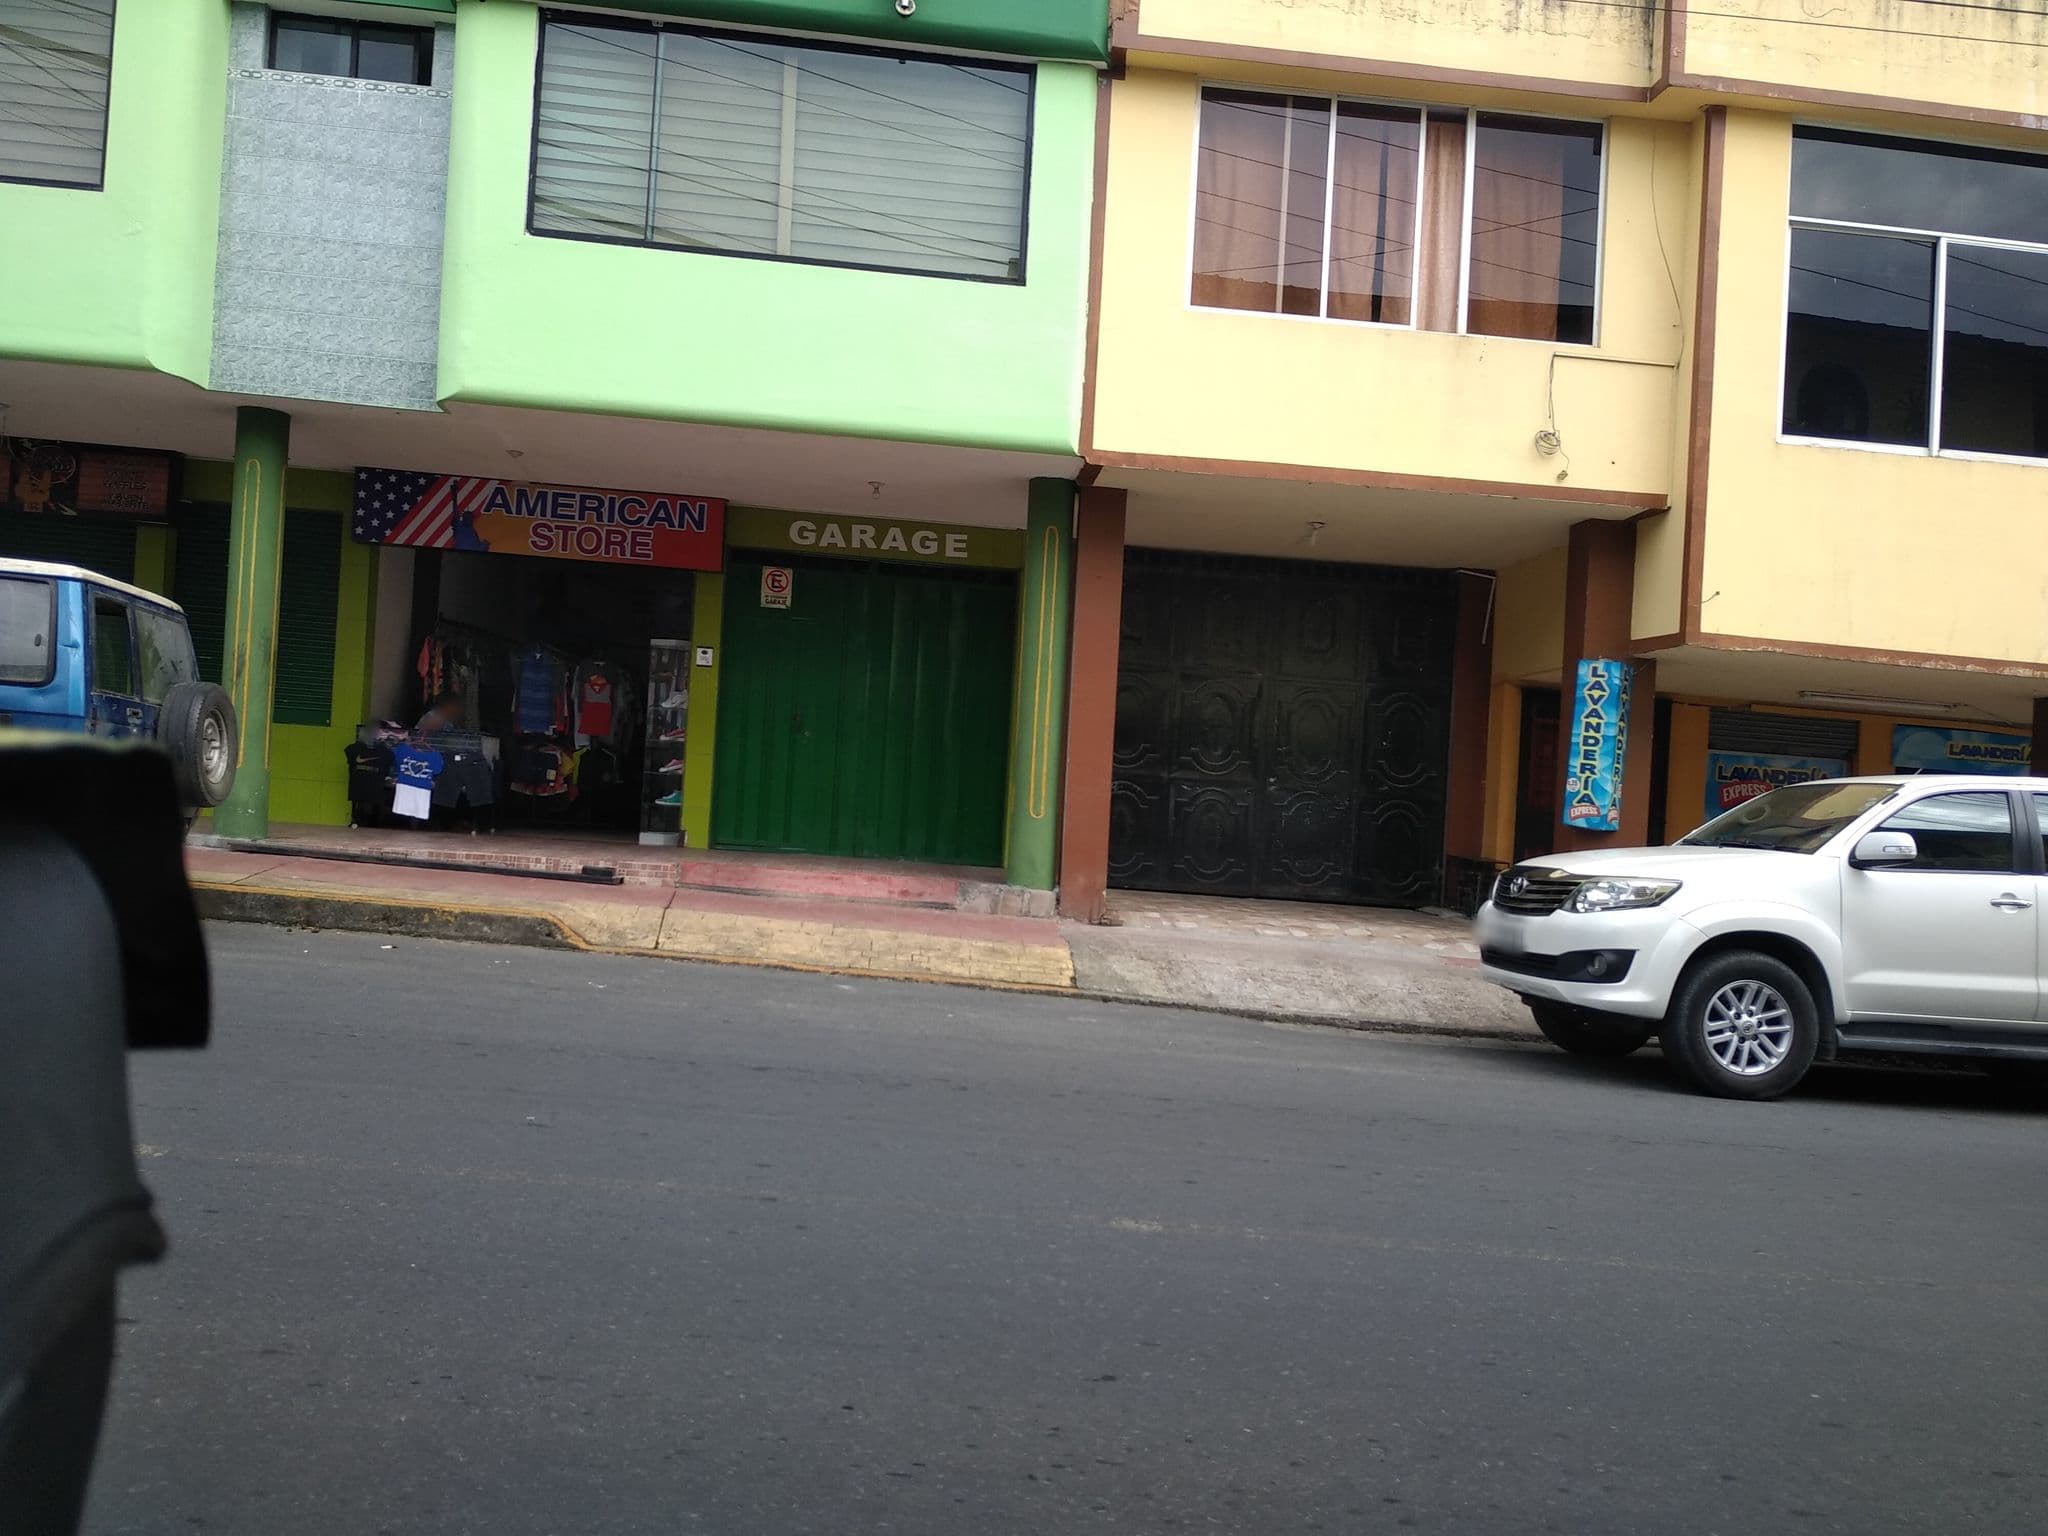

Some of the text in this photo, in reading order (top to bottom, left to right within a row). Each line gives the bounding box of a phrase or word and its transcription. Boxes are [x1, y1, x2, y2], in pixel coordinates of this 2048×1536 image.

[483, 485, 707, 532] AMERICAN
[529, 521, 654, 560] STORE
[789, 520, 968, 558] GARAGE
[1723, 783, 1767, 802] EXPRESS
